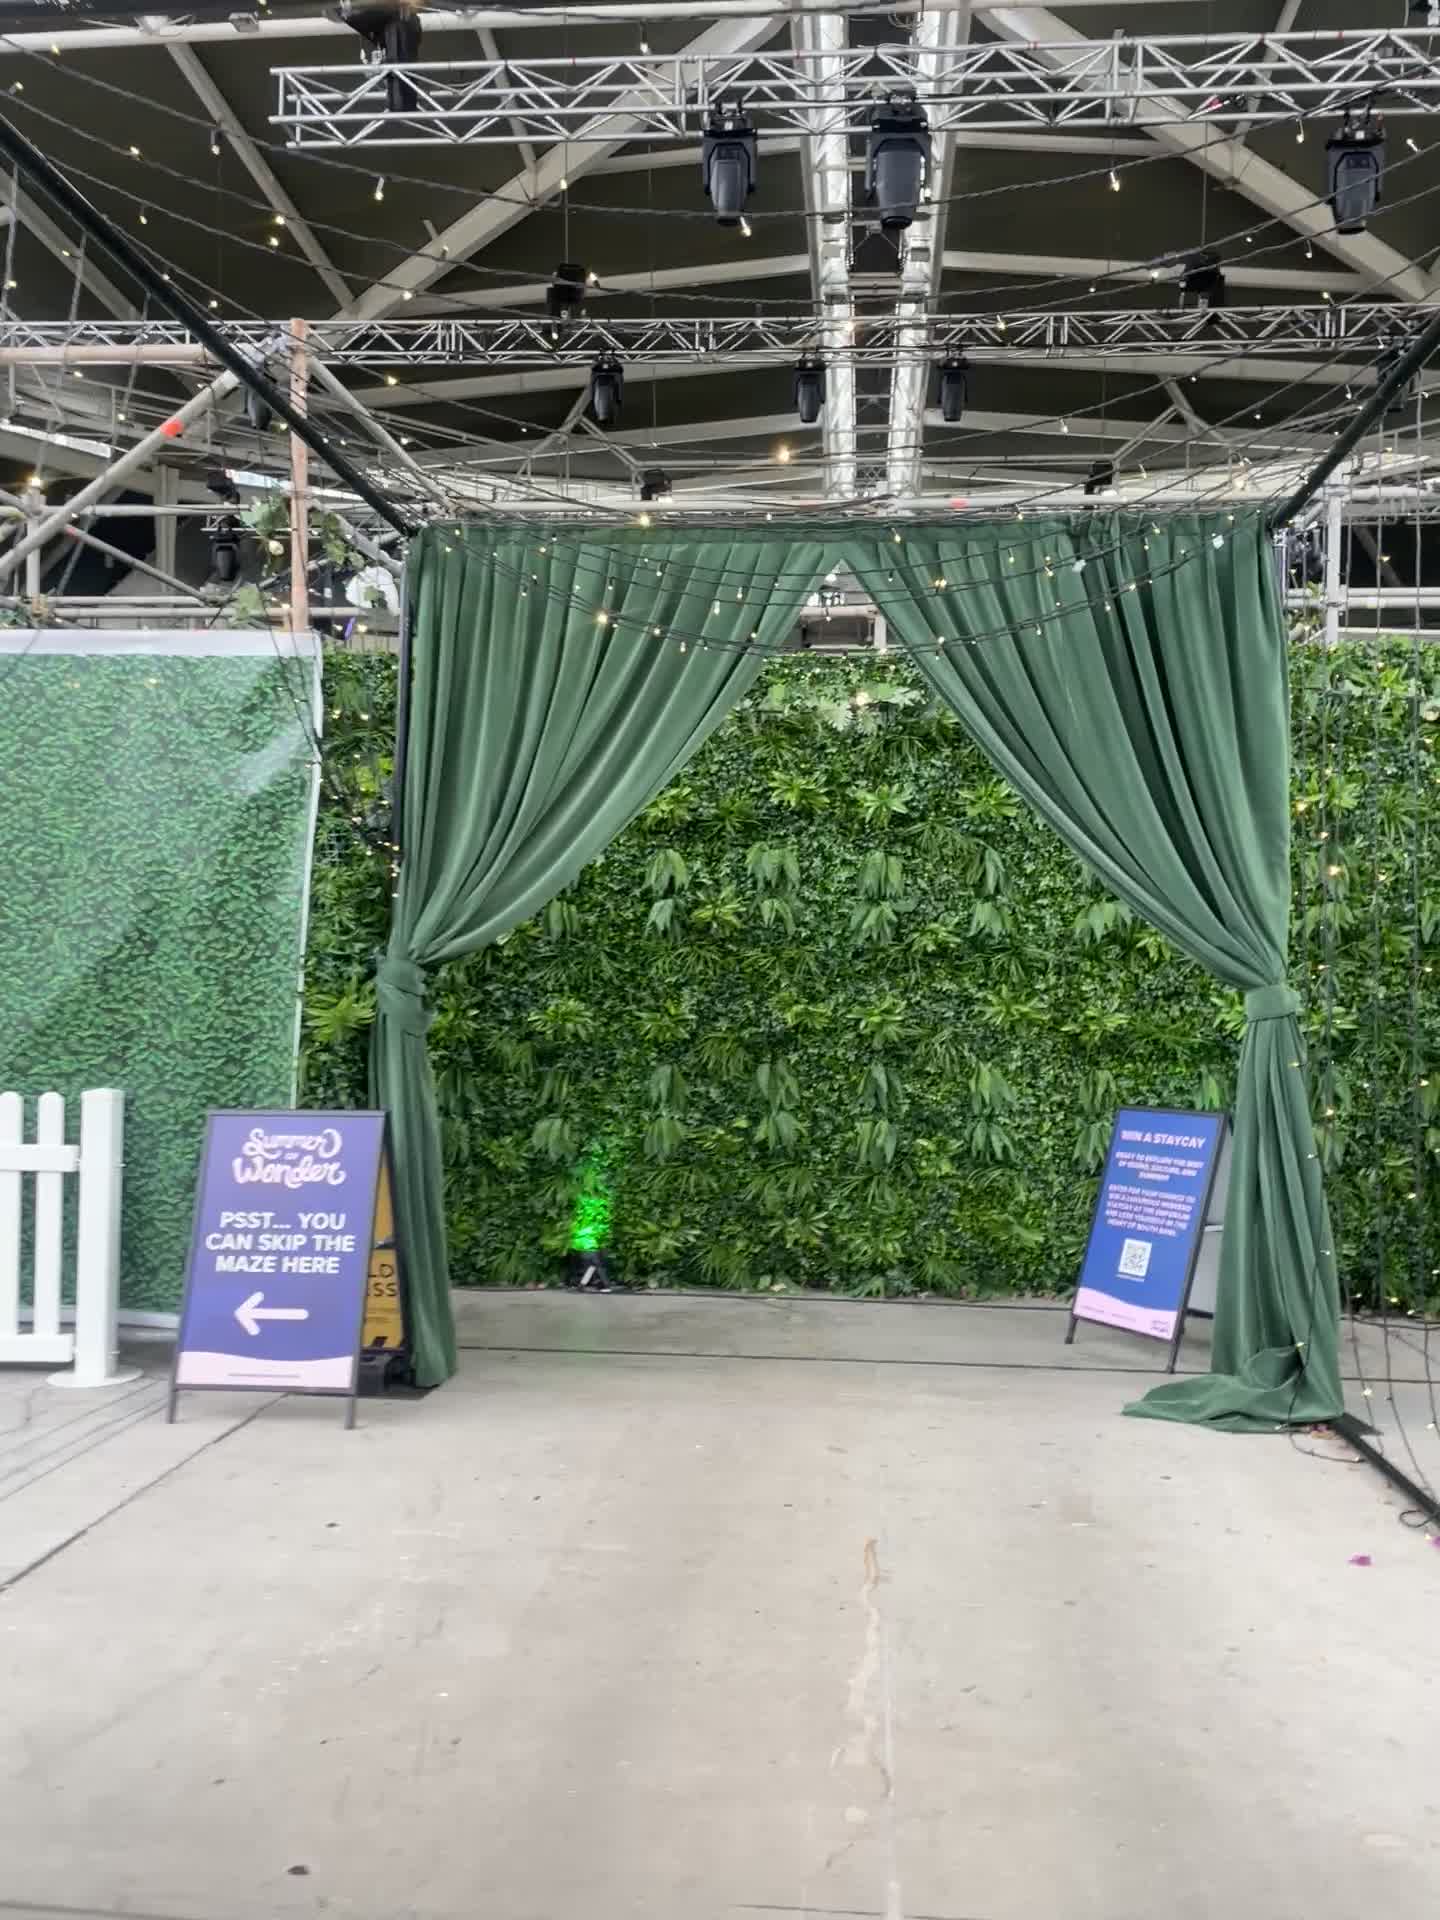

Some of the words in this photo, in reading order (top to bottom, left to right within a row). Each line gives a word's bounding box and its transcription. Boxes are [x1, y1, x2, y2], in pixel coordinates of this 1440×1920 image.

[242, 1128, 342, 1160] Summer
[1143, 1132, 1153, 1143] A
[1153, 1133, 1206, 1148] STAYCAY
[232, 1156, 347, 1189] Wonder
[220, 1212, 291, 1229] PSST...
[298, 1212, 347, 1230] YOU
[205, 1233, 253, 1251] CAN
[257, 1234, 307, 1251] SKIP
[312, 1234, 356, 1252] THE
[216, 1255, 278, 1273] MAZE
[282, 1256, 341, 1274] HERE
